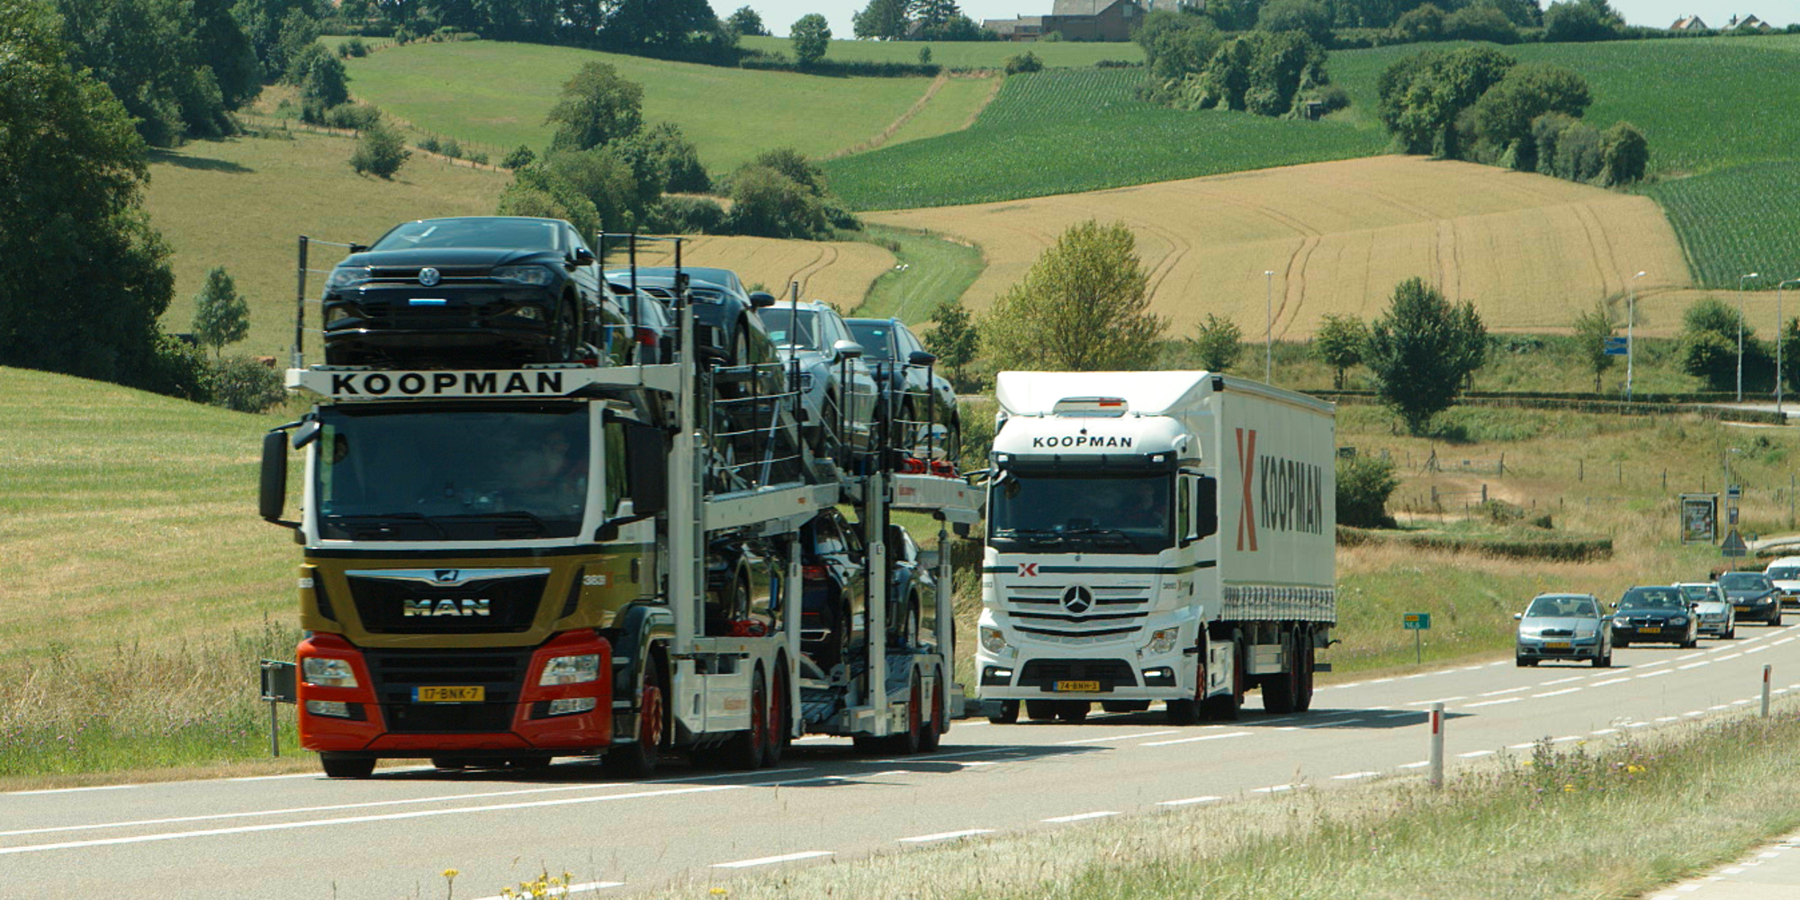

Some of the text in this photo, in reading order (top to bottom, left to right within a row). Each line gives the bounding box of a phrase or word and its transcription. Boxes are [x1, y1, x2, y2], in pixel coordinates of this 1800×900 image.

[332, 372, 562, 395] KOOPMAN
[1033, 436, 1132, 448] KOOPMAN
[1261, 455, 1322, 535] KOOPMAN
[404, 599, 490, 616] MAN
[424, 688, 478, 700] 17-BNK-7
